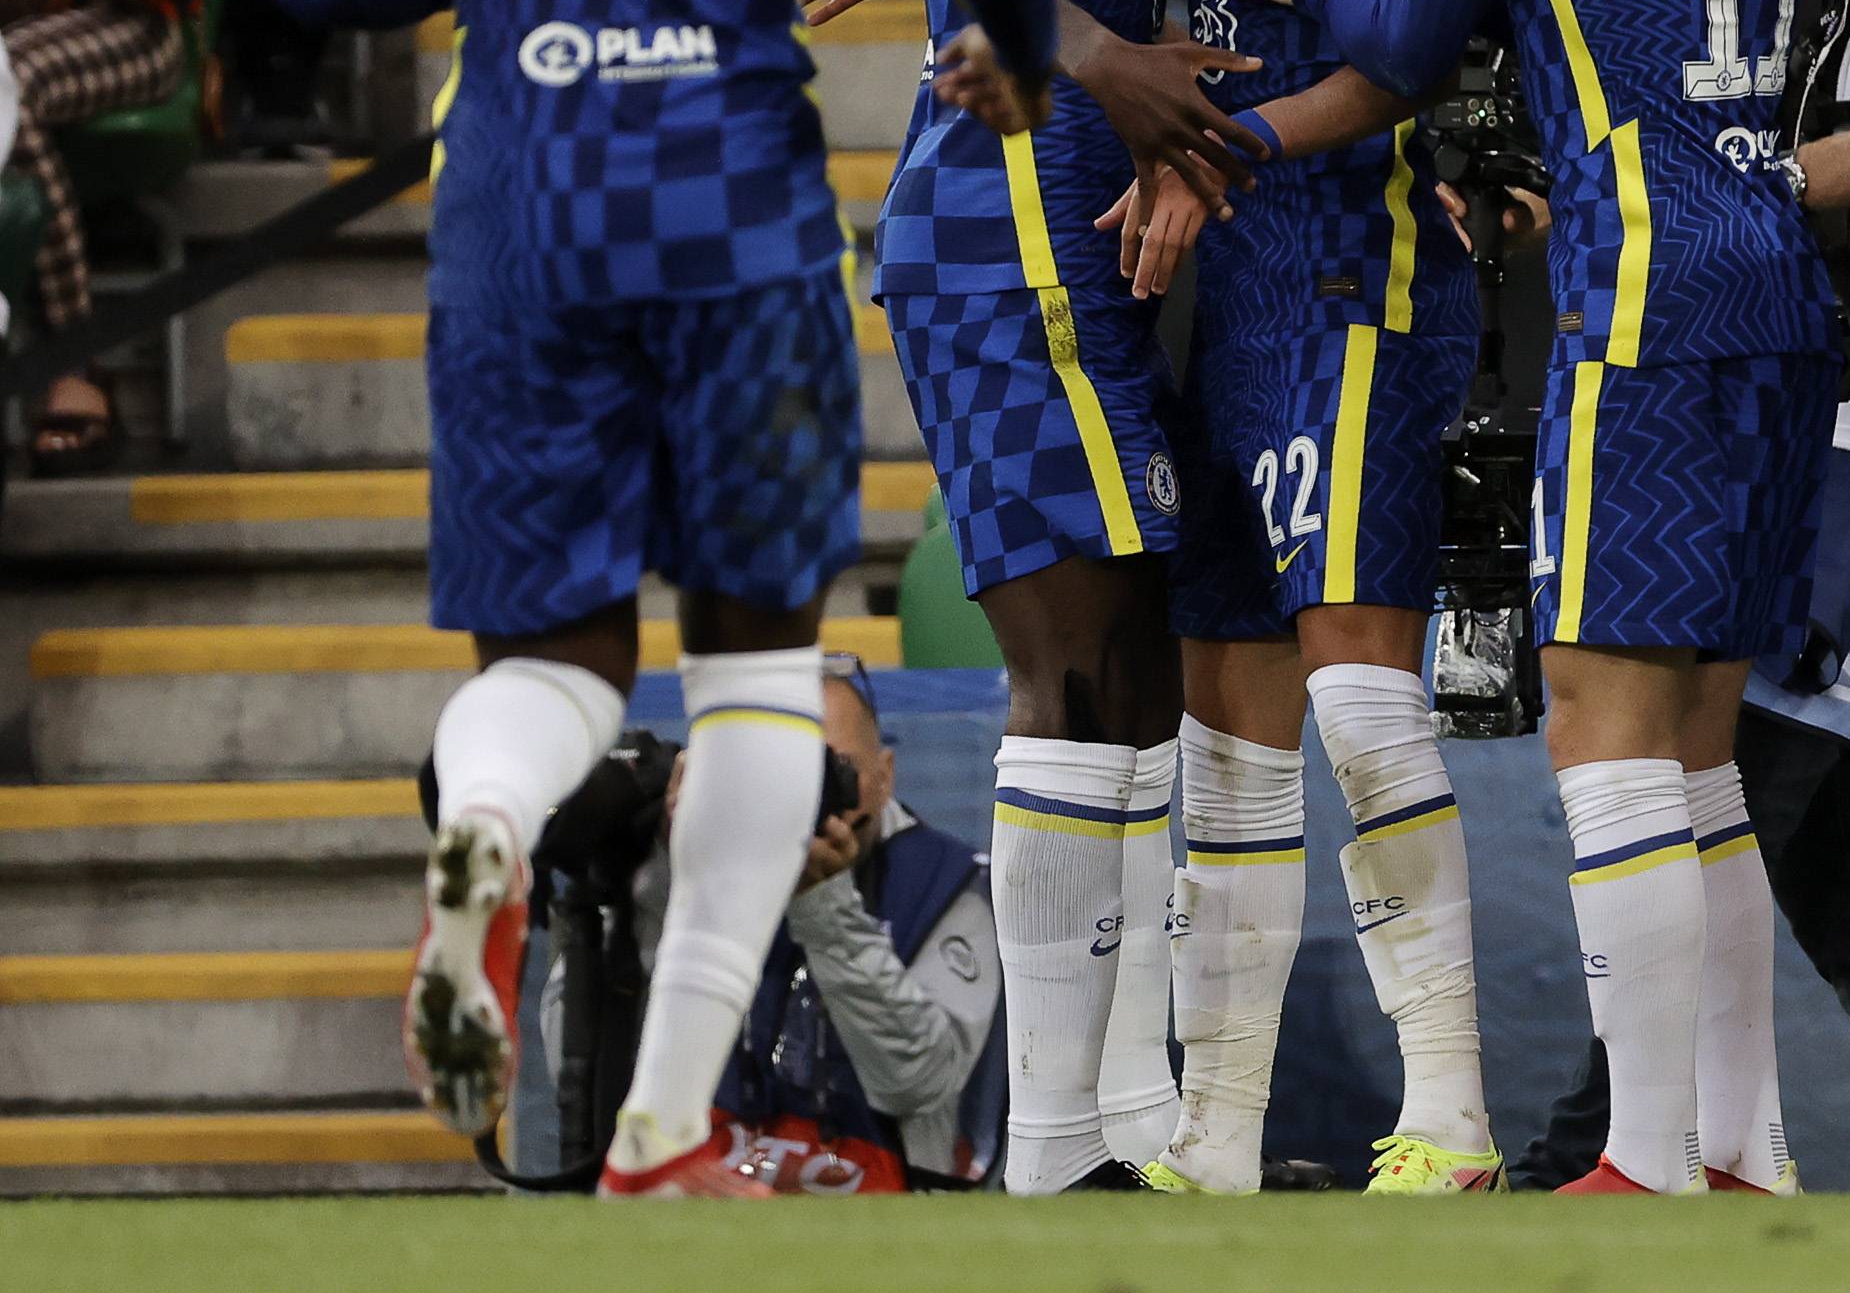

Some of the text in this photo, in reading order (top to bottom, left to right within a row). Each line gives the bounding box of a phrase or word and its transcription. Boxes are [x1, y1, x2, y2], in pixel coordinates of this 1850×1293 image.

[596, 25, 717, 66] PLAN
[1251, 436, 1321, 548] 22
[1353, 896, 1405, 915] CFC
